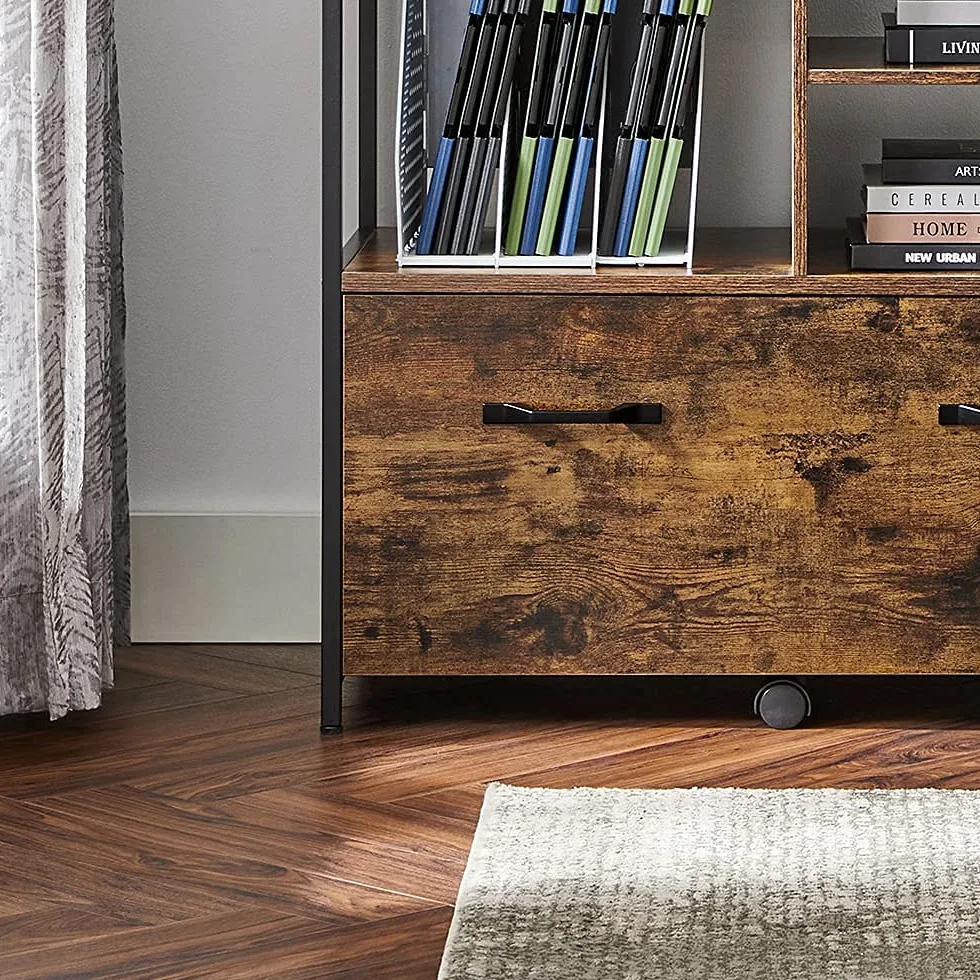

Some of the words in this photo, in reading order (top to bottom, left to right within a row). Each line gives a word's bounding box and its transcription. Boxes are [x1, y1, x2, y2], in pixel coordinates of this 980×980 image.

[891, 193, 980, 207] CEREAL
[912, 222, 967, 236] HOME
[905, 253, 932, 263] NEW
[936, 253, 976, 263] URBAN
